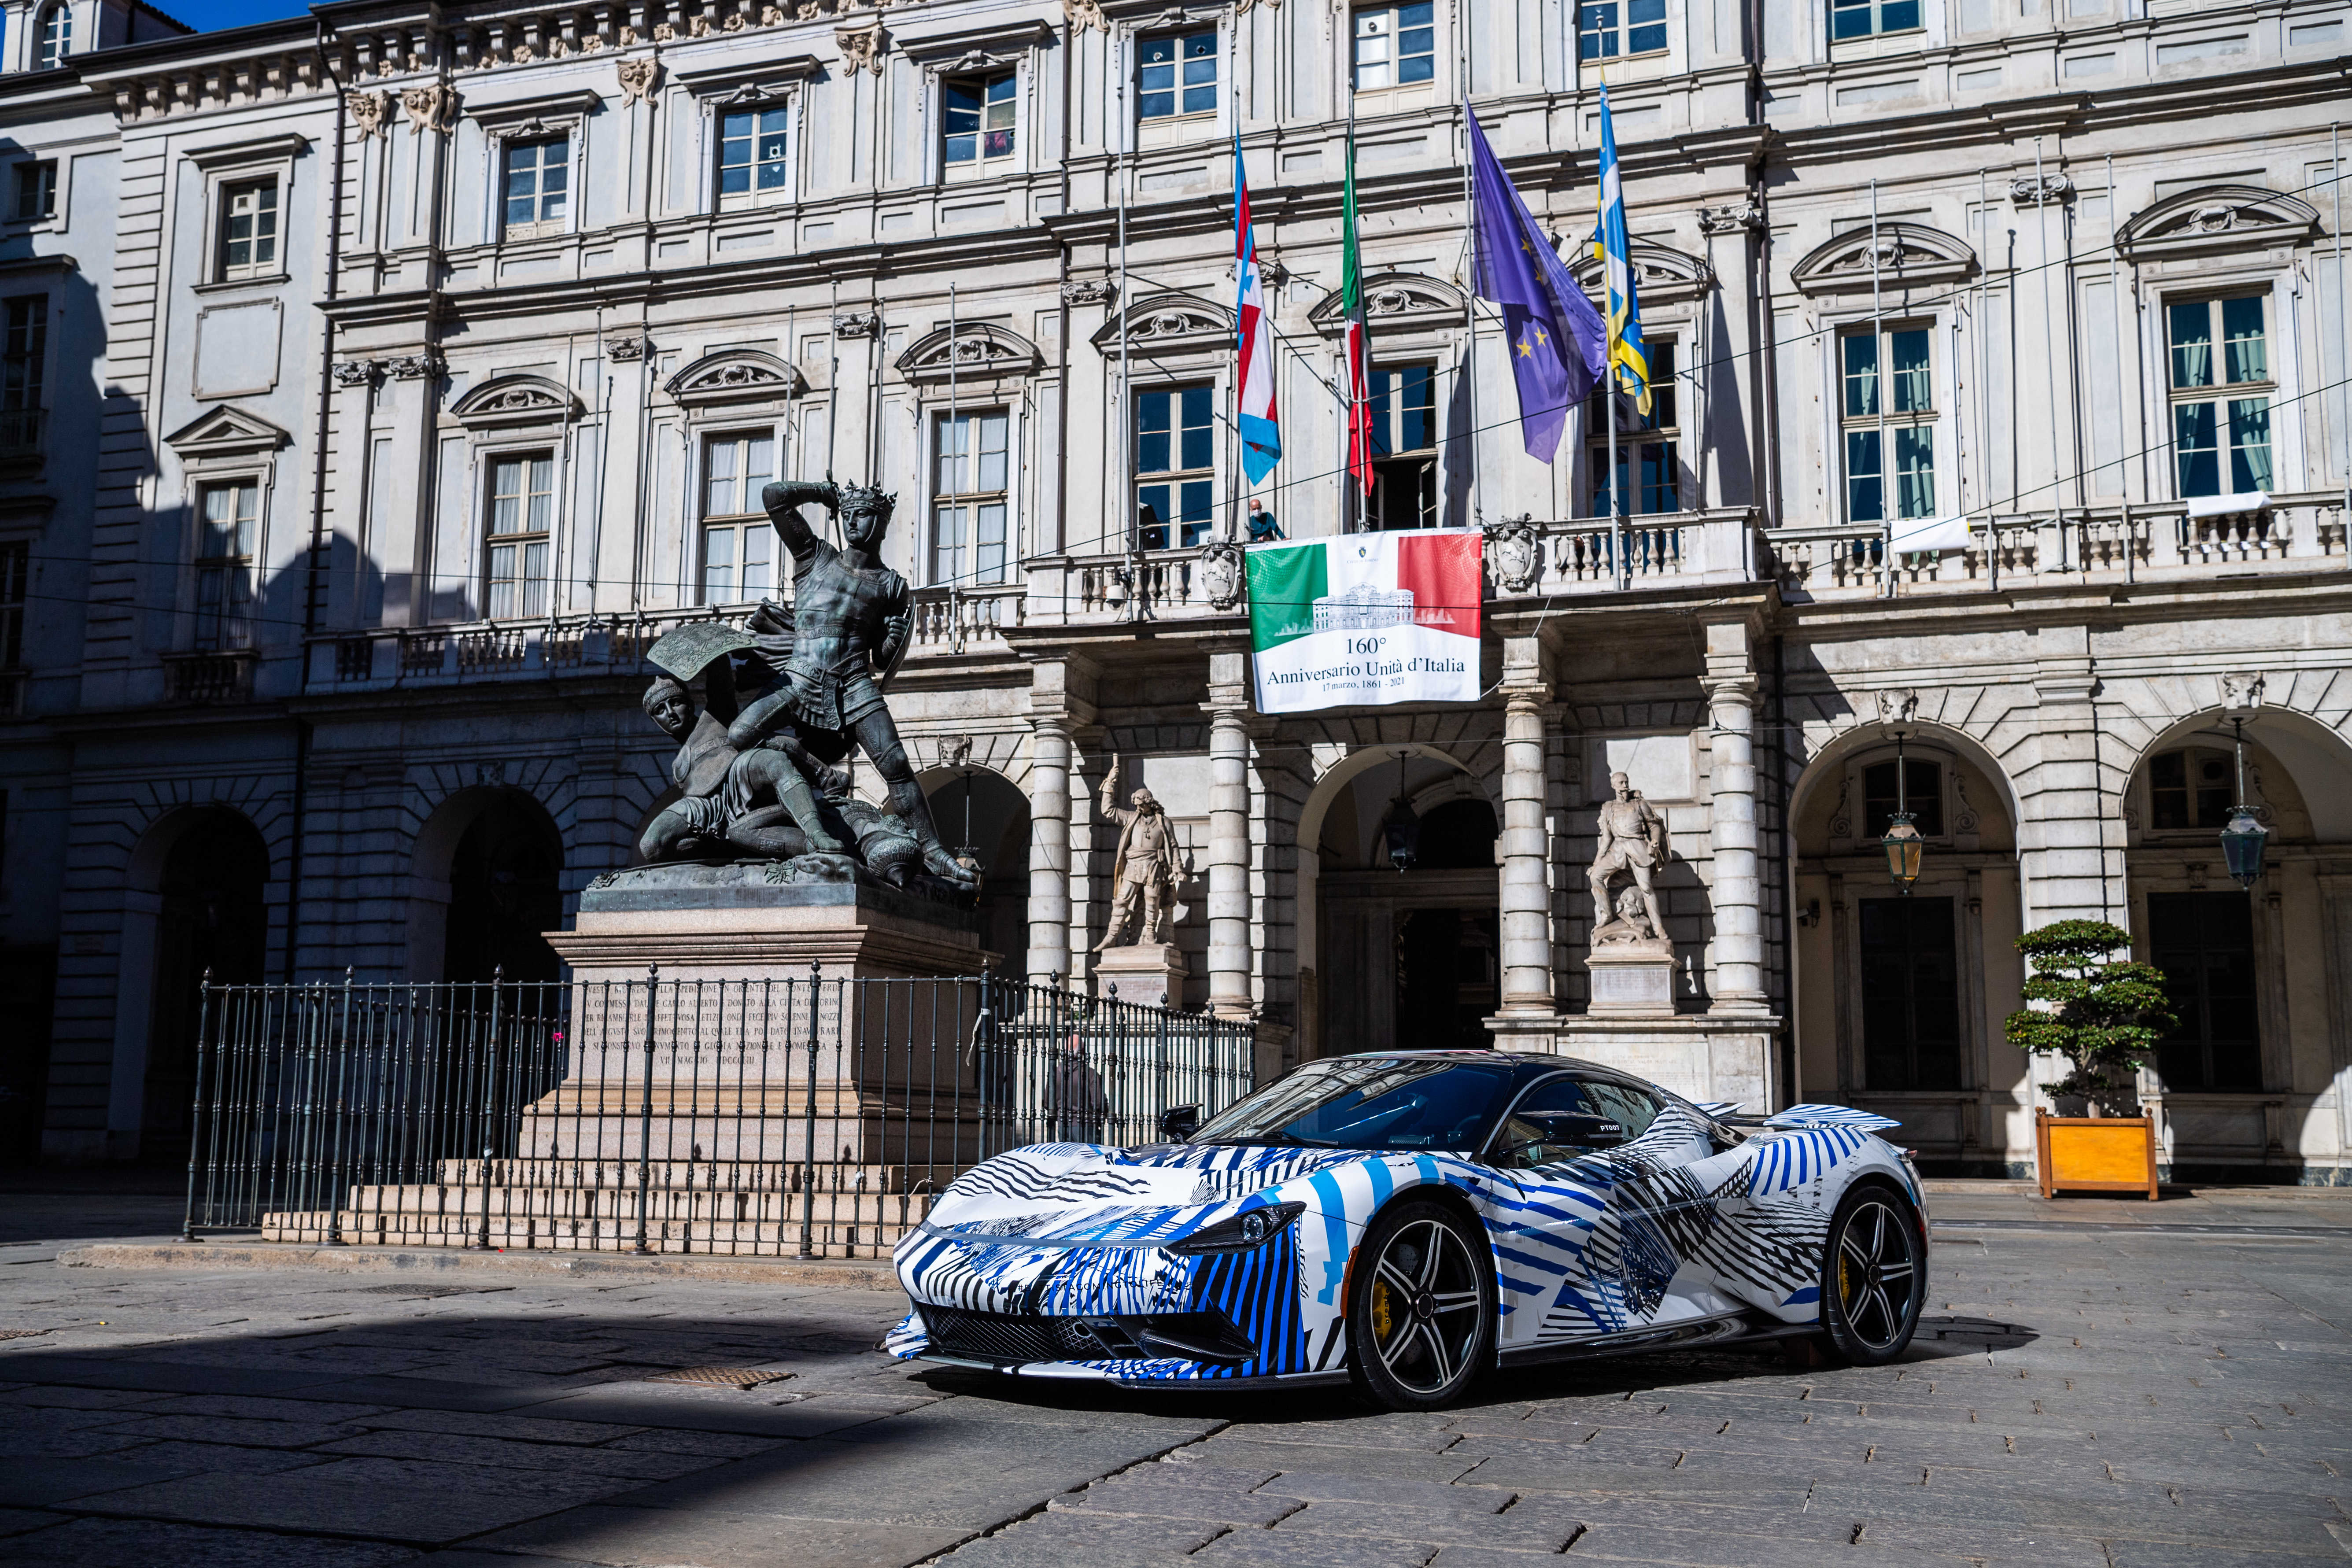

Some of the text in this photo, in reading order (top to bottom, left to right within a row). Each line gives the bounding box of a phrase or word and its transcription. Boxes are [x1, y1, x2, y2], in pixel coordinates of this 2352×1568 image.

[1346, 637, 1386, 654] 160°
[1267, 657, 1465, 685] Anniversario Unità d'Italia
[1322, 683, 1330, 692] 17
[1332, 682, 1359, 690] marzo,
[1362, 680, 1381, 688] 1861
[1390, 676, 1404, 687] 2021
[733, 985, 764, 993] ORENTE
[688, 999, 718, 1007] ALERTO
[698, 1013, 722, 1022] ETIZI
[727, 1013, 745, 1021] OND
[704, 1041, 731, 1050] GLOIA
[677, 1056, 708, 1064] MAGIO
[1017, 1279, 1165, 1291] #BTISTACOMINGTOLIFE
